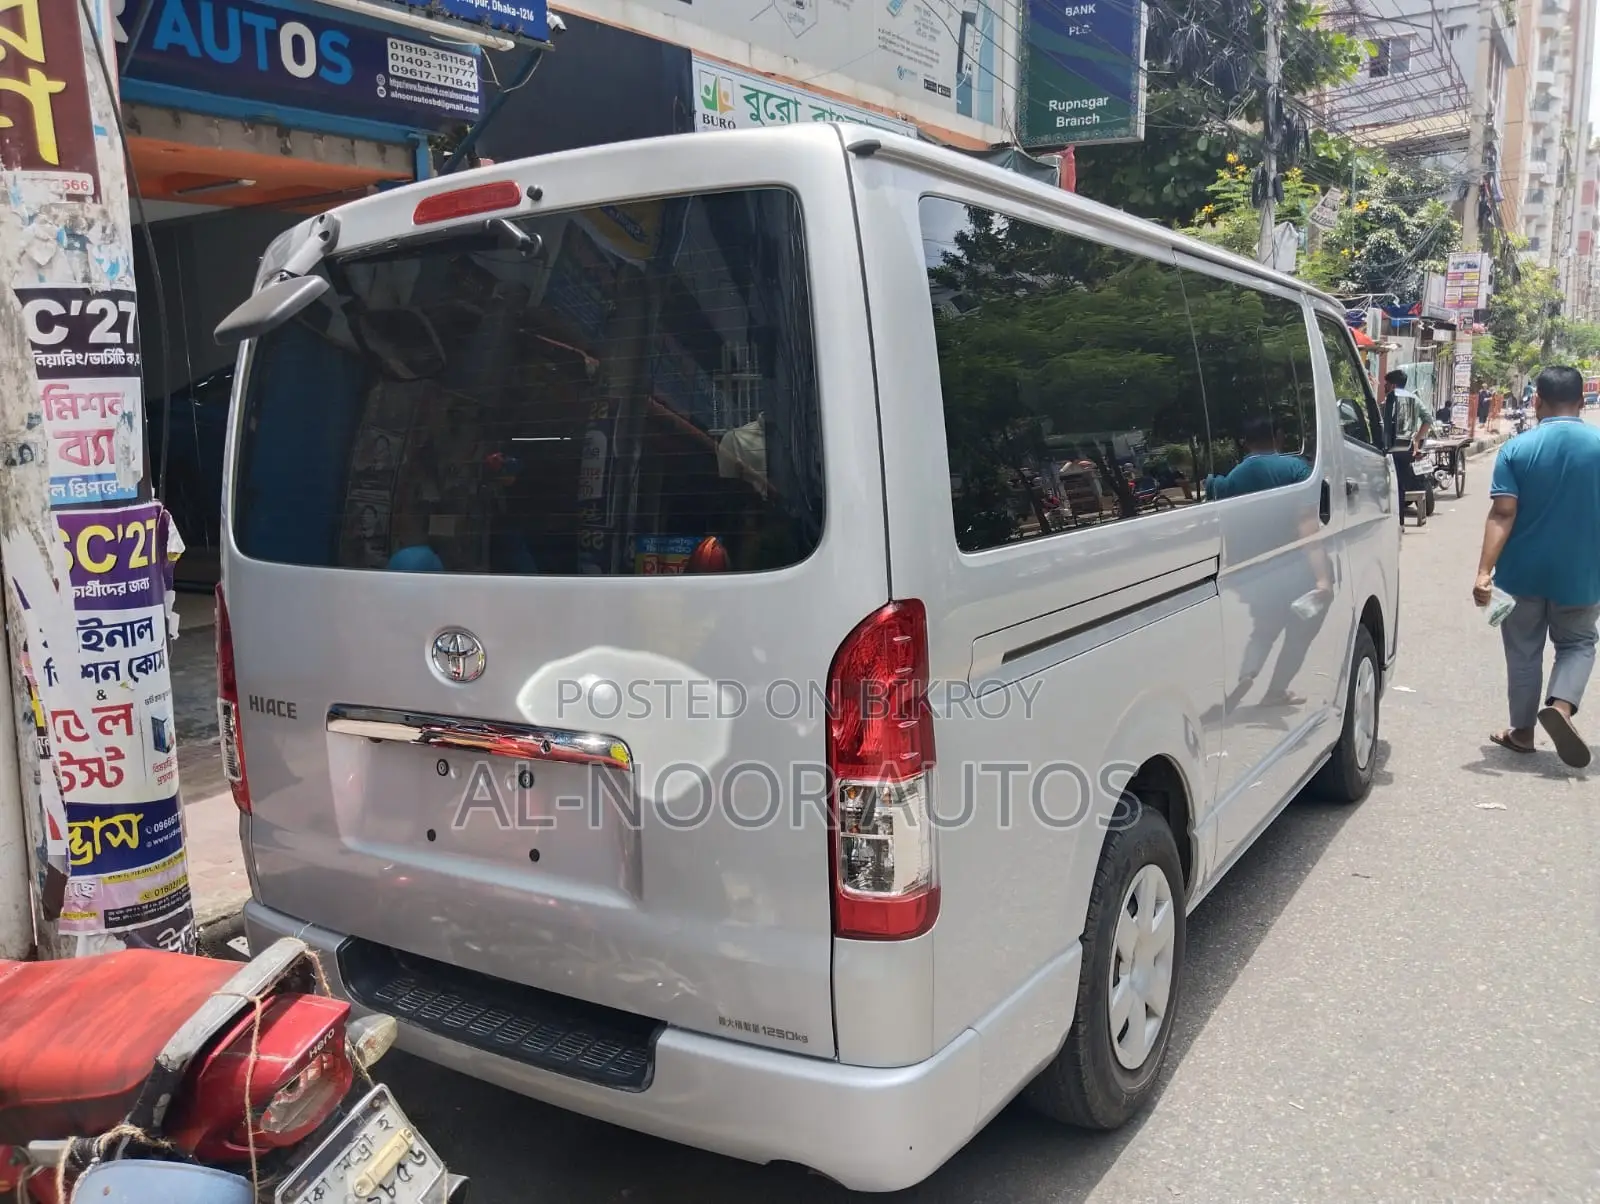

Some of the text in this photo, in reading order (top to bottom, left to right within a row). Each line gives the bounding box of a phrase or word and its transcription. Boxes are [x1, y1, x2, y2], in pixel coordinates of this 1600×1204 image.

[491, 0, 534, 21] Dhaka-1216
[1065, 4, 1096, 16] BANK
[152, 0, 354, 85] AUTOS
[391, 53, 475, 79] 01403-111777
[391, 64, 477, 91] 09617-171841
[740, 84, 802, 127] বুরো
[1049, 97, 1109, 112] Rupnagar
[702, 114, 737, 130] BURO
[1056, 113, 1100, 128] Branch
[96, 689, 107, 700] &
[248, 694, 298, 720] HIACE
[309, 1027, 335, 1060] Hero
